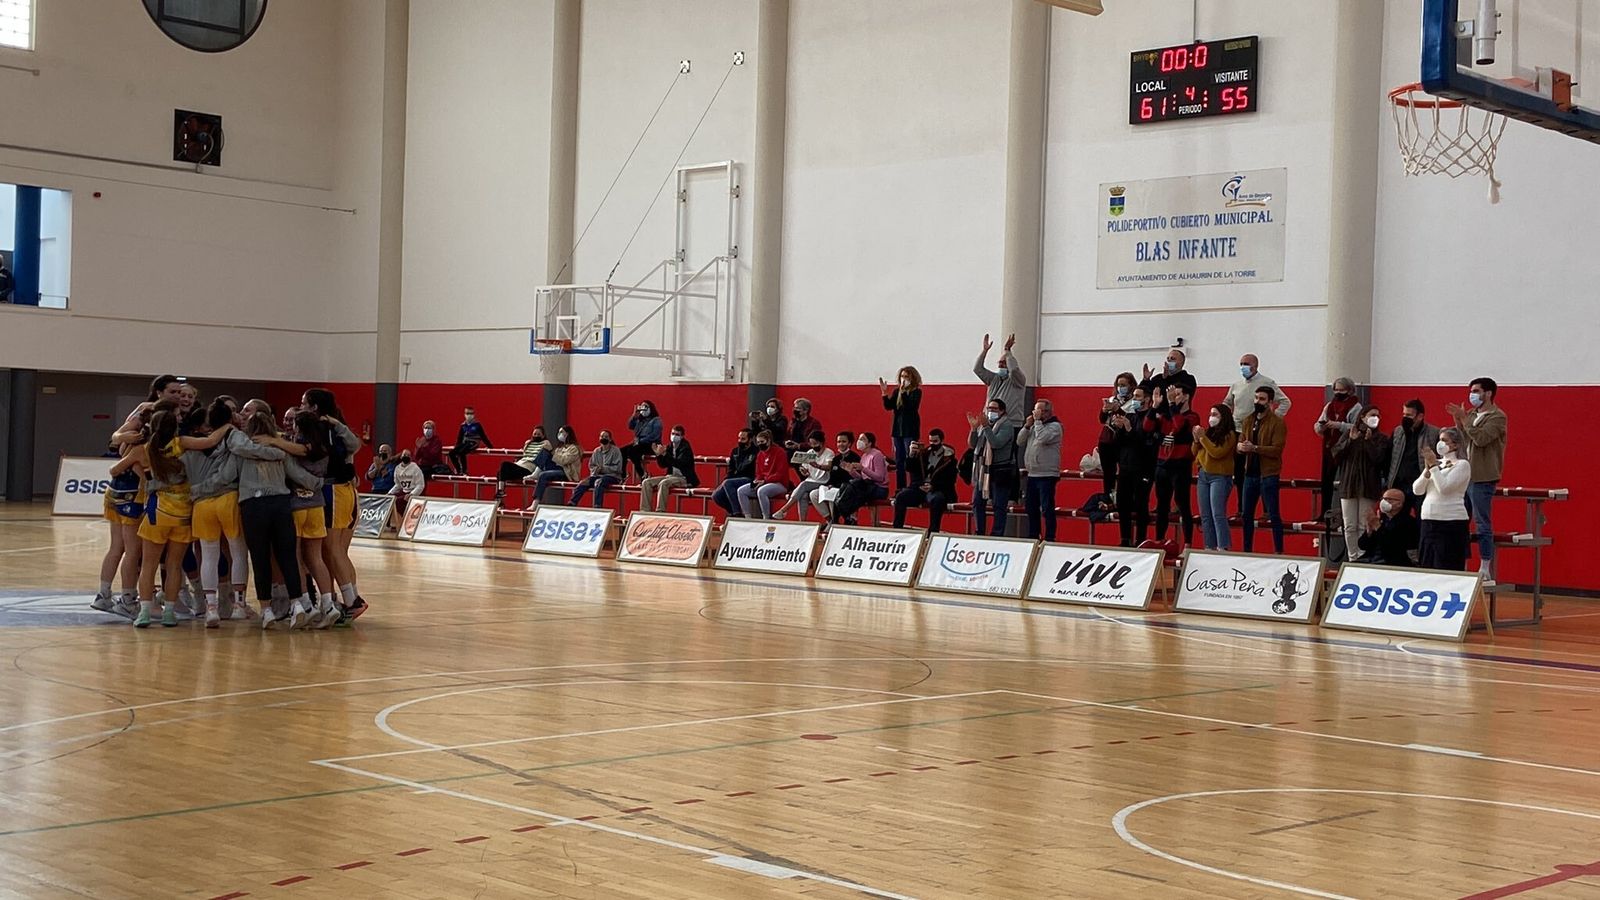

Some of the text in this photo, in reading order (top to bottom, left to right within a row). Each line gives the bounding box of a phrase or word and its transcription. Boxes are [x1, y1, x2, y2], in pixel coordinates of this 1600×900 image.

[1215, 69, 1248, 83] VISITANTE
[1135, 80, 1167, 93] LOCAL
[1185, 86, 1196, 101] 4
[1221, 86, 1249, 110] 55
[1141, 97, 1167, 119] 61
[1178, 104, 1202, 115] PERIODO
[1107, 210, 1273, 232] POLIDEPORTIVO CUBIERTO MUNICIPAL
[1135, 237, 1237, 262] BLAS INFANTE
[1117, 273, 1167, 282] AYUNTAMIENTO
[1214, 271, 1222, 279] DE
[1233, 270, 1256, 278] TORRE
[65, 479, 111, 494] asis
[359, 508, 388, 521] RSAN
[632, 521, 703, 543] Quality Closets
[719, 542, 806, 564] Ayuntamiento
[841, 536, 906, 554] Alhaurín
[825, 553, 909, 573] de la Torre
[1186, 567, 1265, 597] Casa Peña
[1057, 589, 1079, 597] marca
[1082, 590, 1093, 598] del
[1094, 590, 1125, 601] deporte
